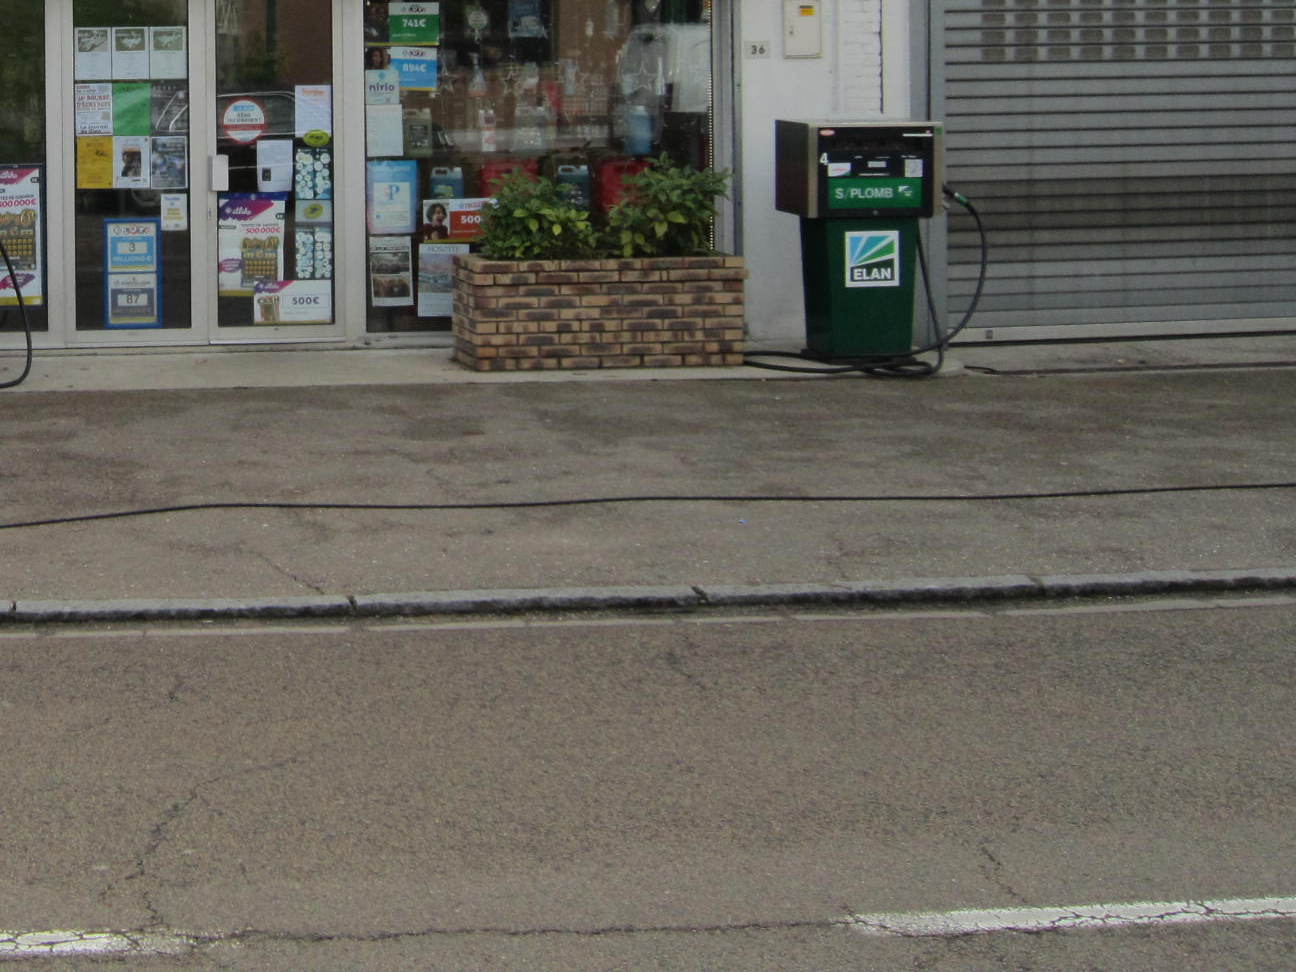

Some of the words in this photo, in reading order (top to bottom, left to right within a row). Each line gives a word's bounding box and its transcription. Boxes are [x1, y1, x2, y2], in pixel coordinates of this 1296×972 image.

[751, 44, 765, 55] 36
[369, 82, 396, 92] nirio
[819, 153, 829, 165] 4
[835, 187, 894, 199] S/PLOMB
[460, 215, 484, 224] 500
[128, 242, 136, 253] 3
[853, 267, 891, 280] ELAN
[126, 293, 140, 305] 87
[292, 296, 320, 305] 500€
